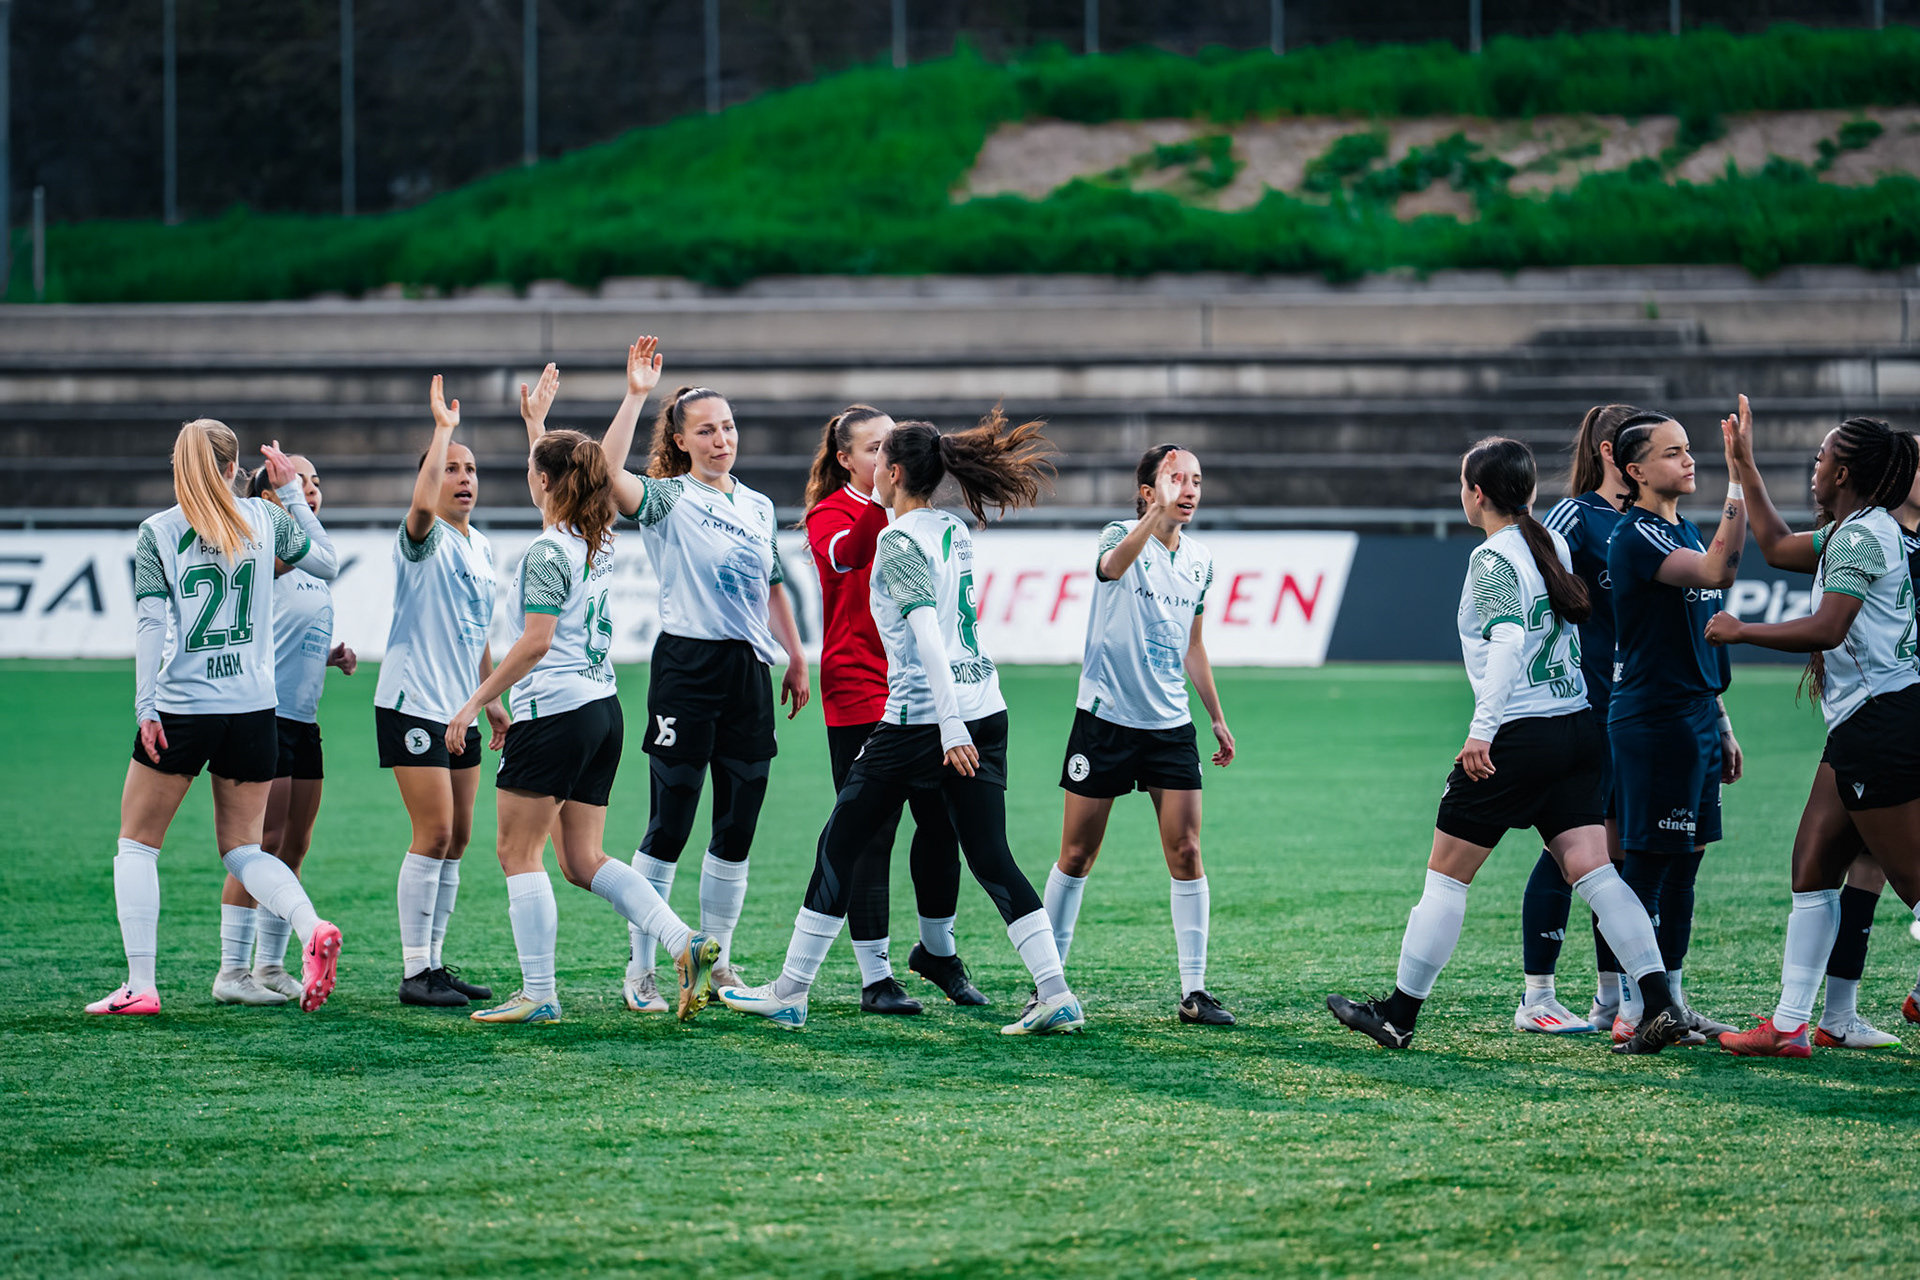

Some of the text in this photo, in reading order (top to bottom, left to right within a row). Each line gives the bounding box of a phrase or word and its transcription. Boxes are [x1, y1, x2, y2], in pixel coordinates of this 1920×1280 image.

[179, 558, 256, 653] 21
[206, 651, 244, 680] RAHM
[653, 714, 678, 748] YS
